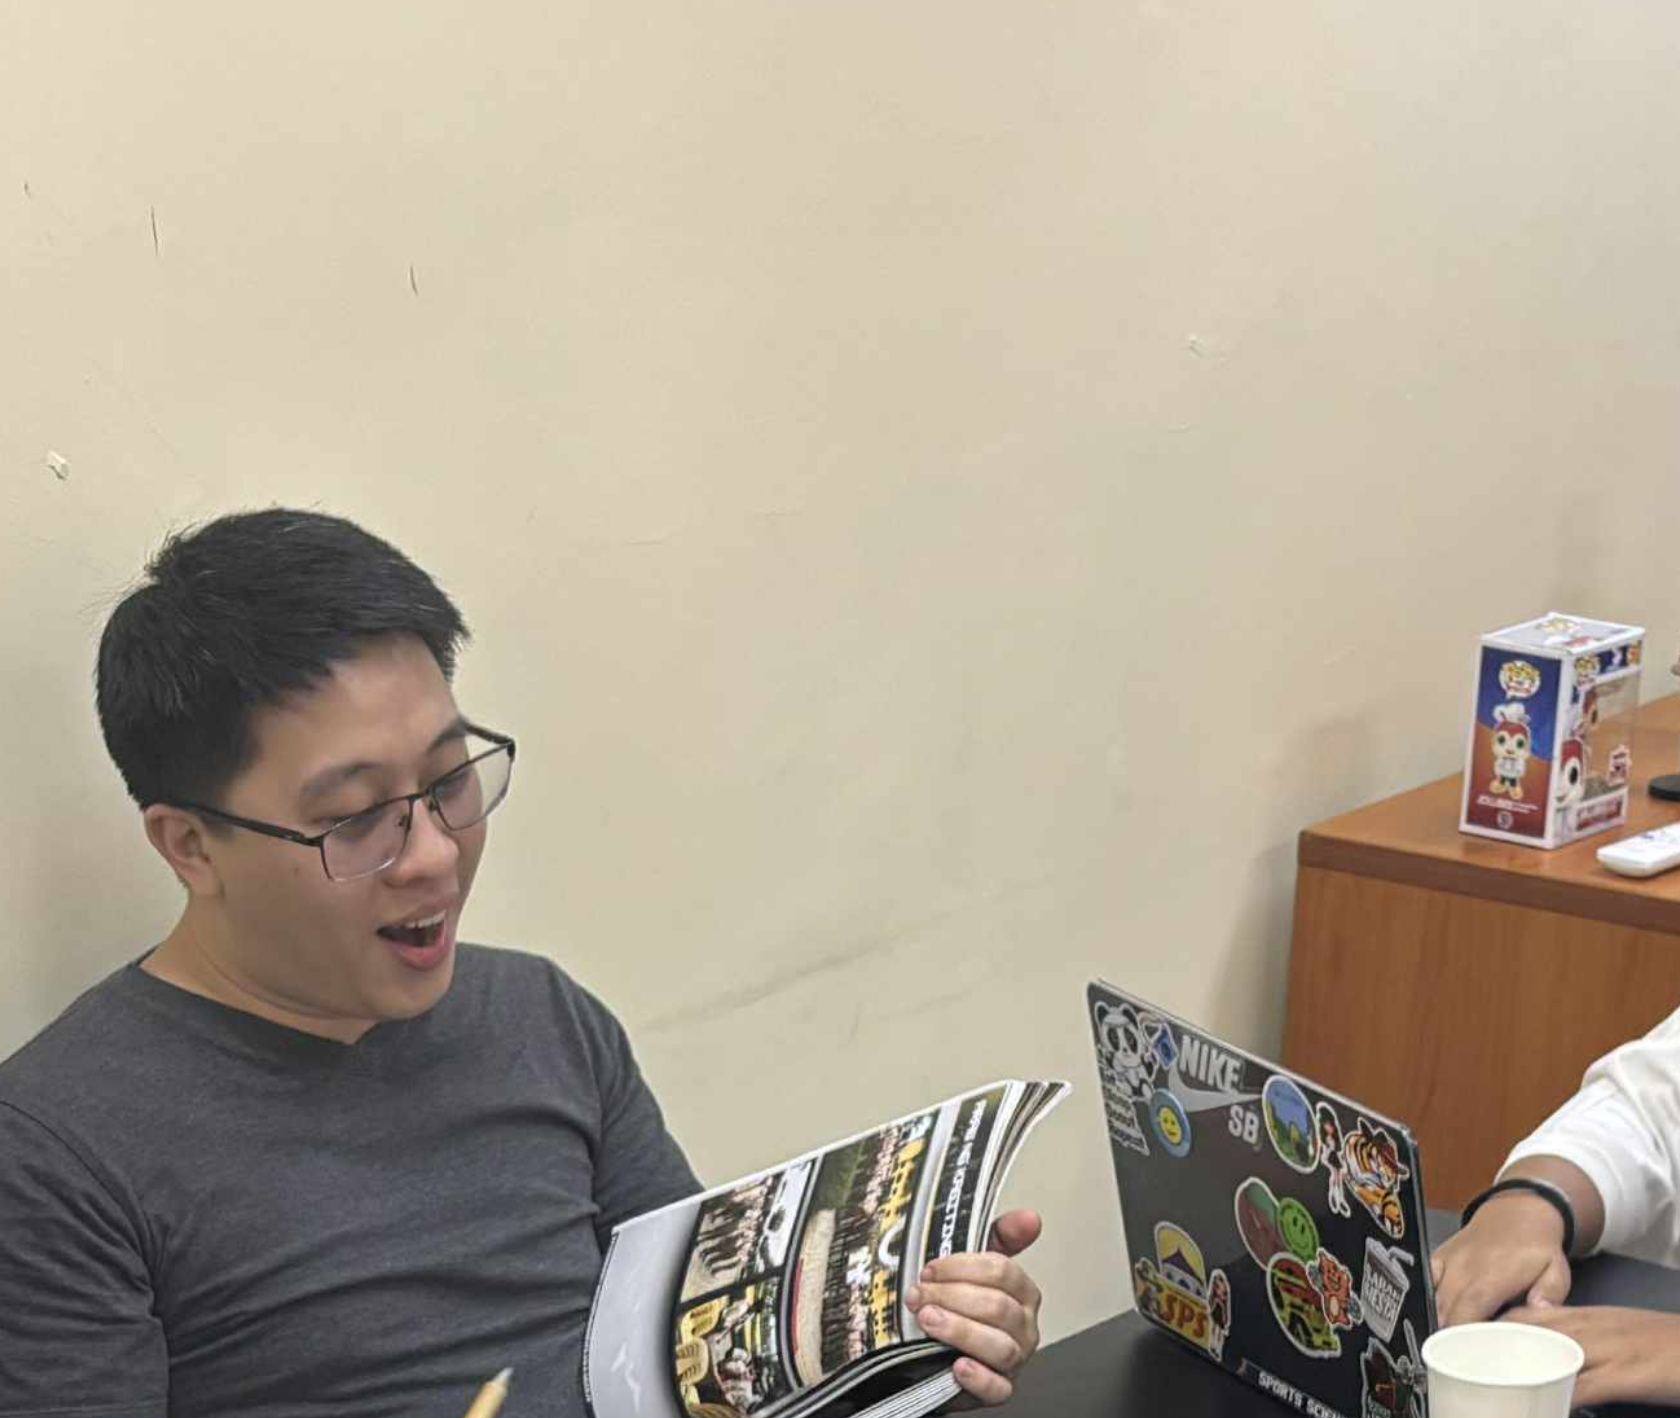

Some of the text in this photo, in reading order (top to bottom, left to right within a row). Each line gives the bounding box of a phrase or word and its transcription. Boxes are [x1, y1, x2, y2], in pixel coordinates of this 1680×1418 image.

[1180, 1034, 1241, 1094] NIKE
[1228, 1105, 1260, 1145] SB
[1258, 1370, 1303, 1408] SPORTS
